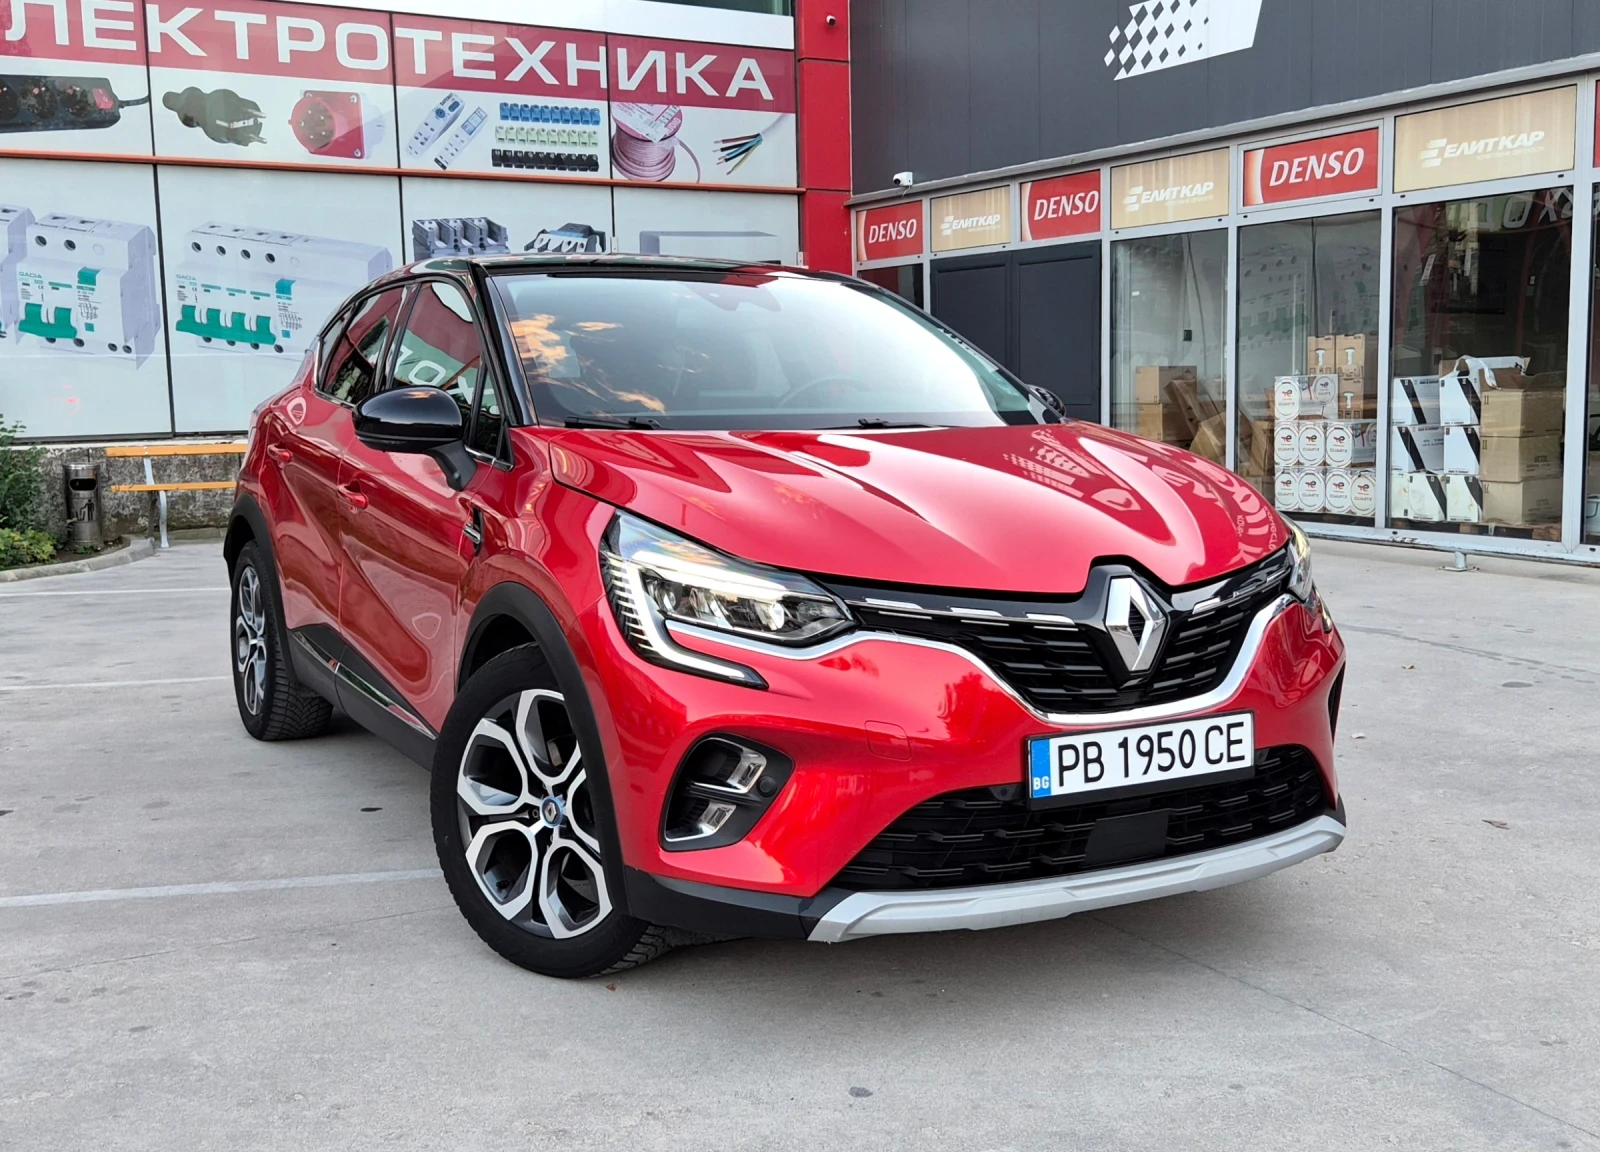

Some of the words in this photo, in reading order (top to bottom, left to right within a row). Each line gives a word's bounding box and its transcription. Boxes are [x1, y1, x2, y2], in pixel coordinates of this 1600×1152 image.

[1268, 147, 1365, 187] DENSO
[1033, 190, 1099, 221] DENSO
[868, 218, 917, 244] DENSO
[1058, 741, 1105, 787] PB
[1118, 728, 1197, 779] 1950
[1205, 721, 1246, 765] CE
[1033, 776, 1050, 790] BG
